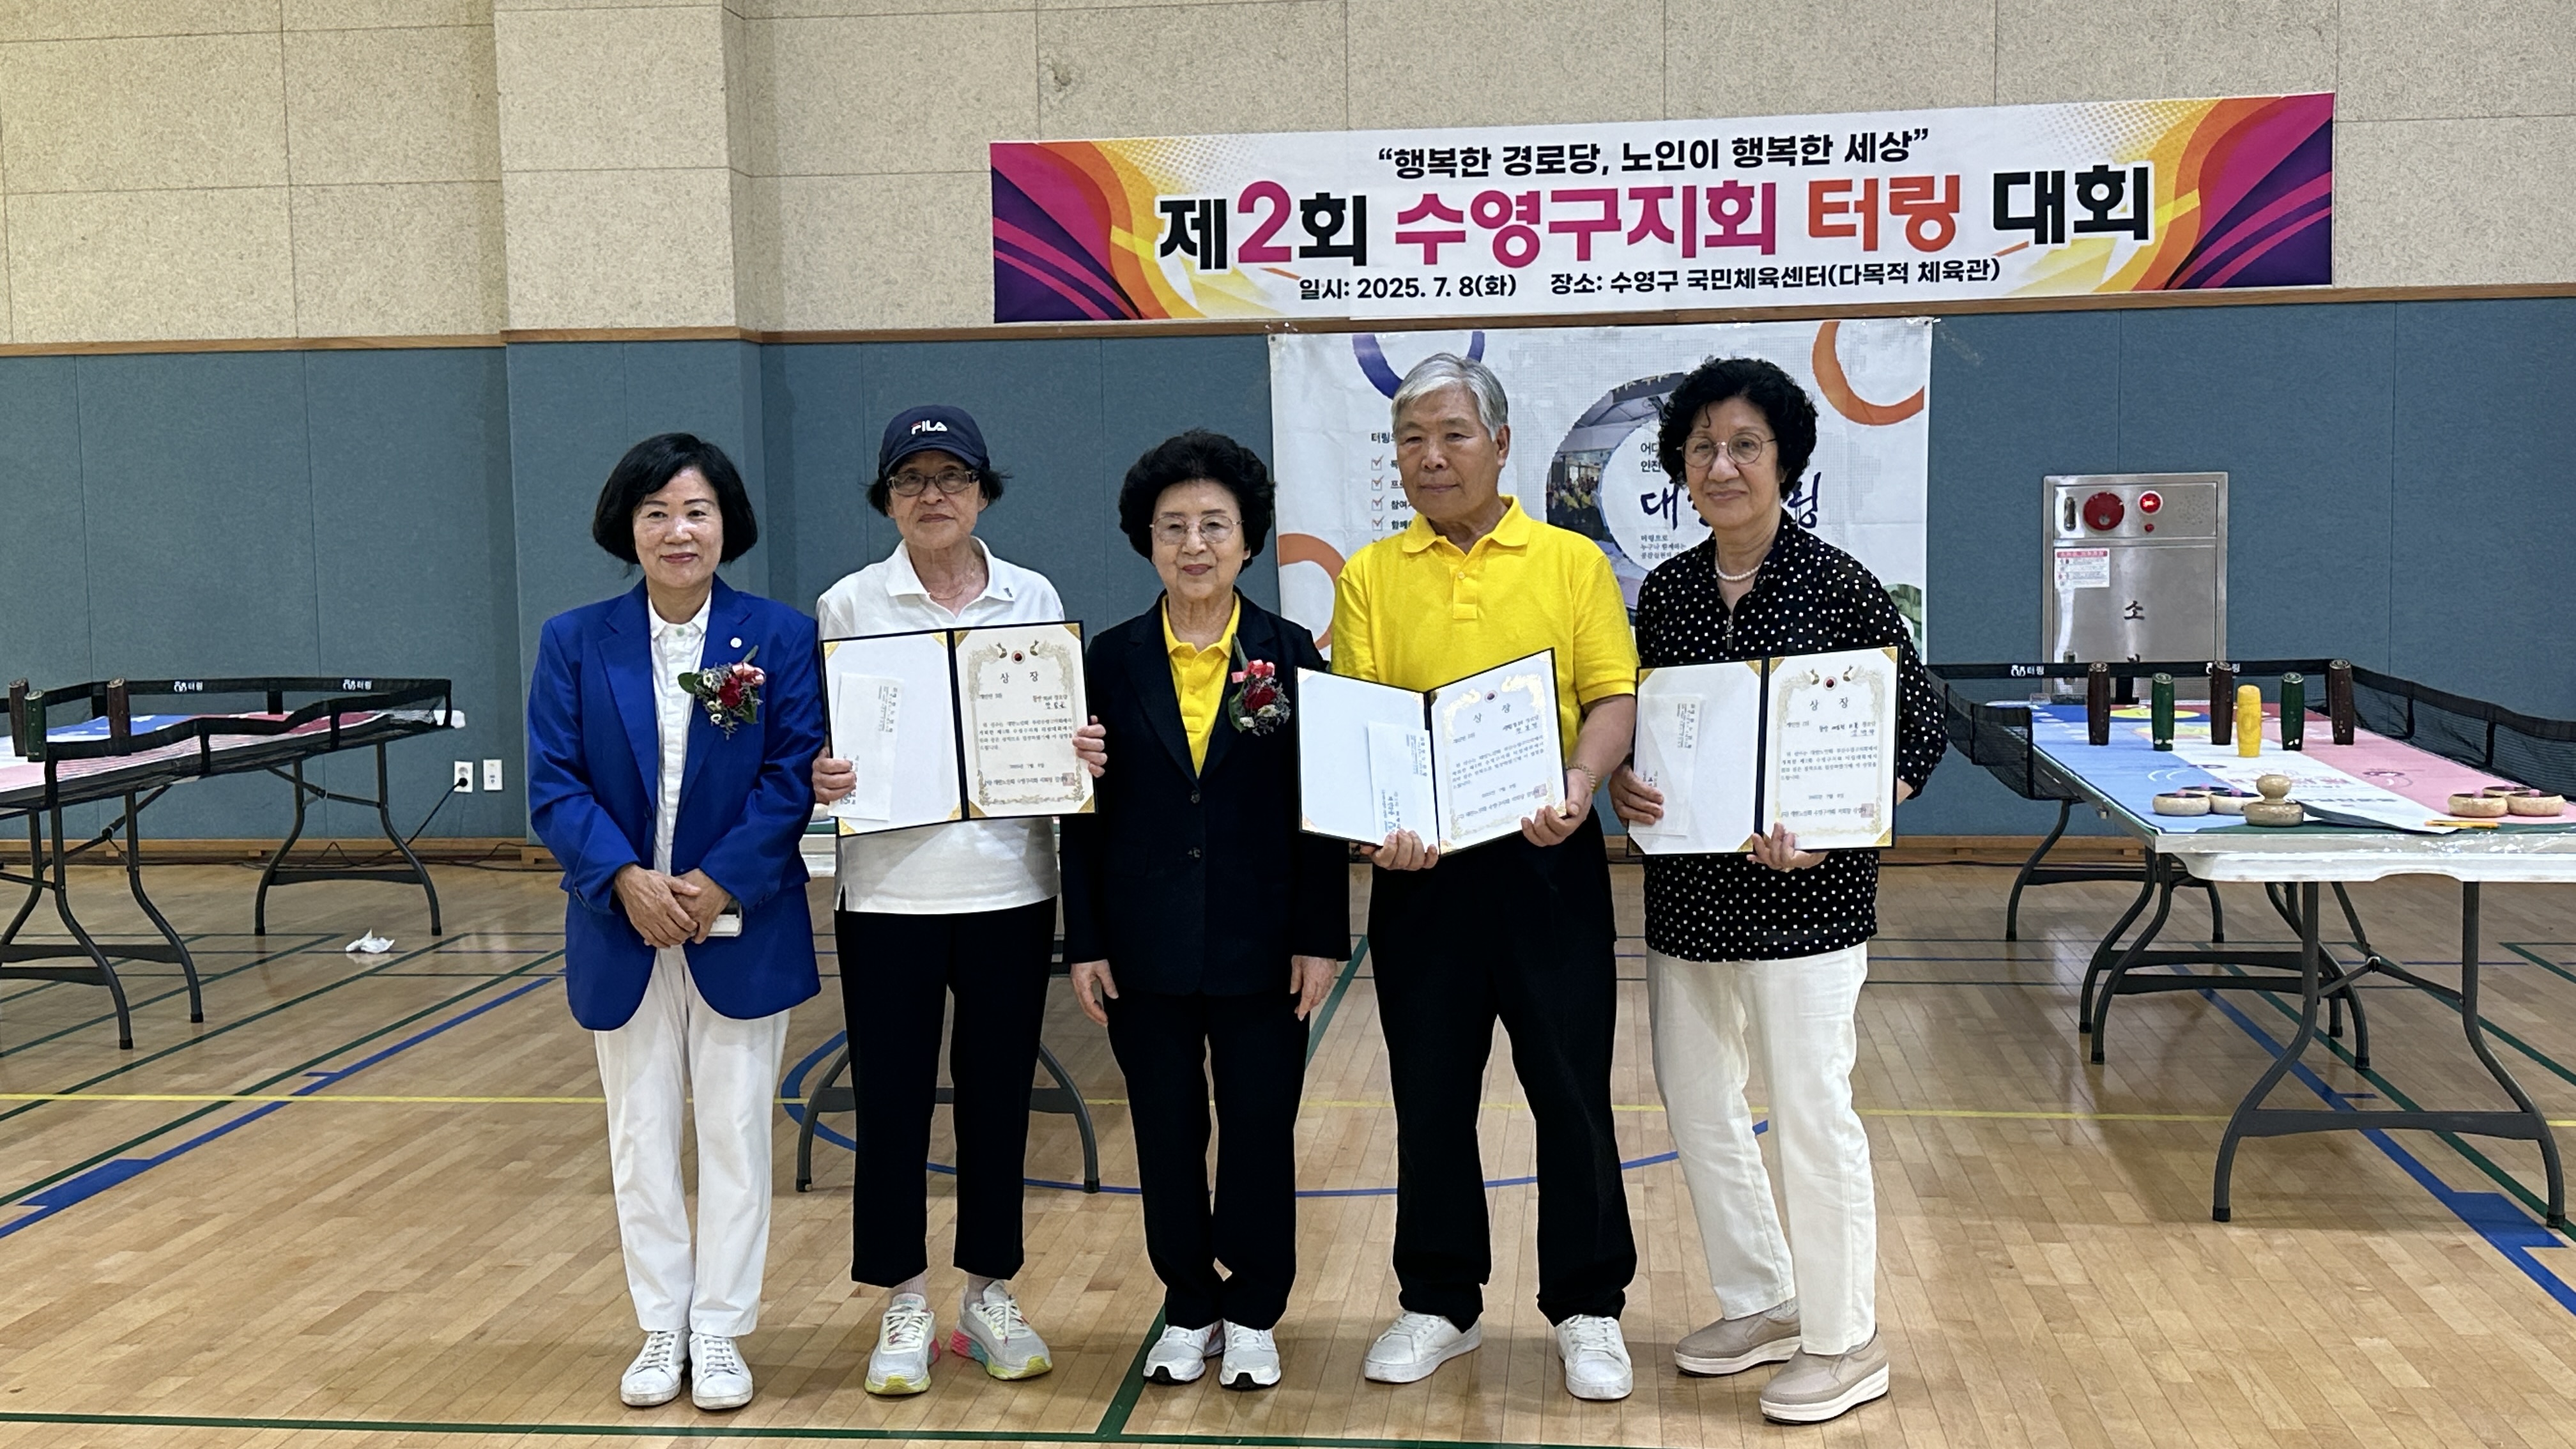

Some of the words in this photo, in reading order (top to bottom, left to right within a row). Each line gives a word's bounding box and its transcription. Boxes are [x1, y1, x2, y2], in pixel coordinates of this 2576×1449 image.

[1379, 147, 1492, 180] “행복한
[1503, 143, 1609, 176] 경로당,
[1621, 139, 1719, 172] 노인이
[1731, 134, 1834, 168] 행복한
[1844, 128, 1929, 163] 세상”
[1159, 180, 1367, 270] 제2회
[1396, 179, 1775, 268] 수영구지회
[1809, 174, 1959, 252] 터링
[1993, 165, 2149, 245] 대회
[1300, 278, 1349, 300] 일시:
[1357, 277, 1426, 298] 2025.
[1434, 277, 1451, 297] 7.
[1459, 274, 1517, 298] 8(화)
[1551, 273, 1602, 295] 장소:
[1610, 270, 1678, 294] 수영구
[1687, 263, 1908, 291] 국민체육센터(다목적
[1917, 258, 2000, 284] 체육관)
[910, 420, 948, 435] FILA
[2124, 600, 2145, 620] 소
